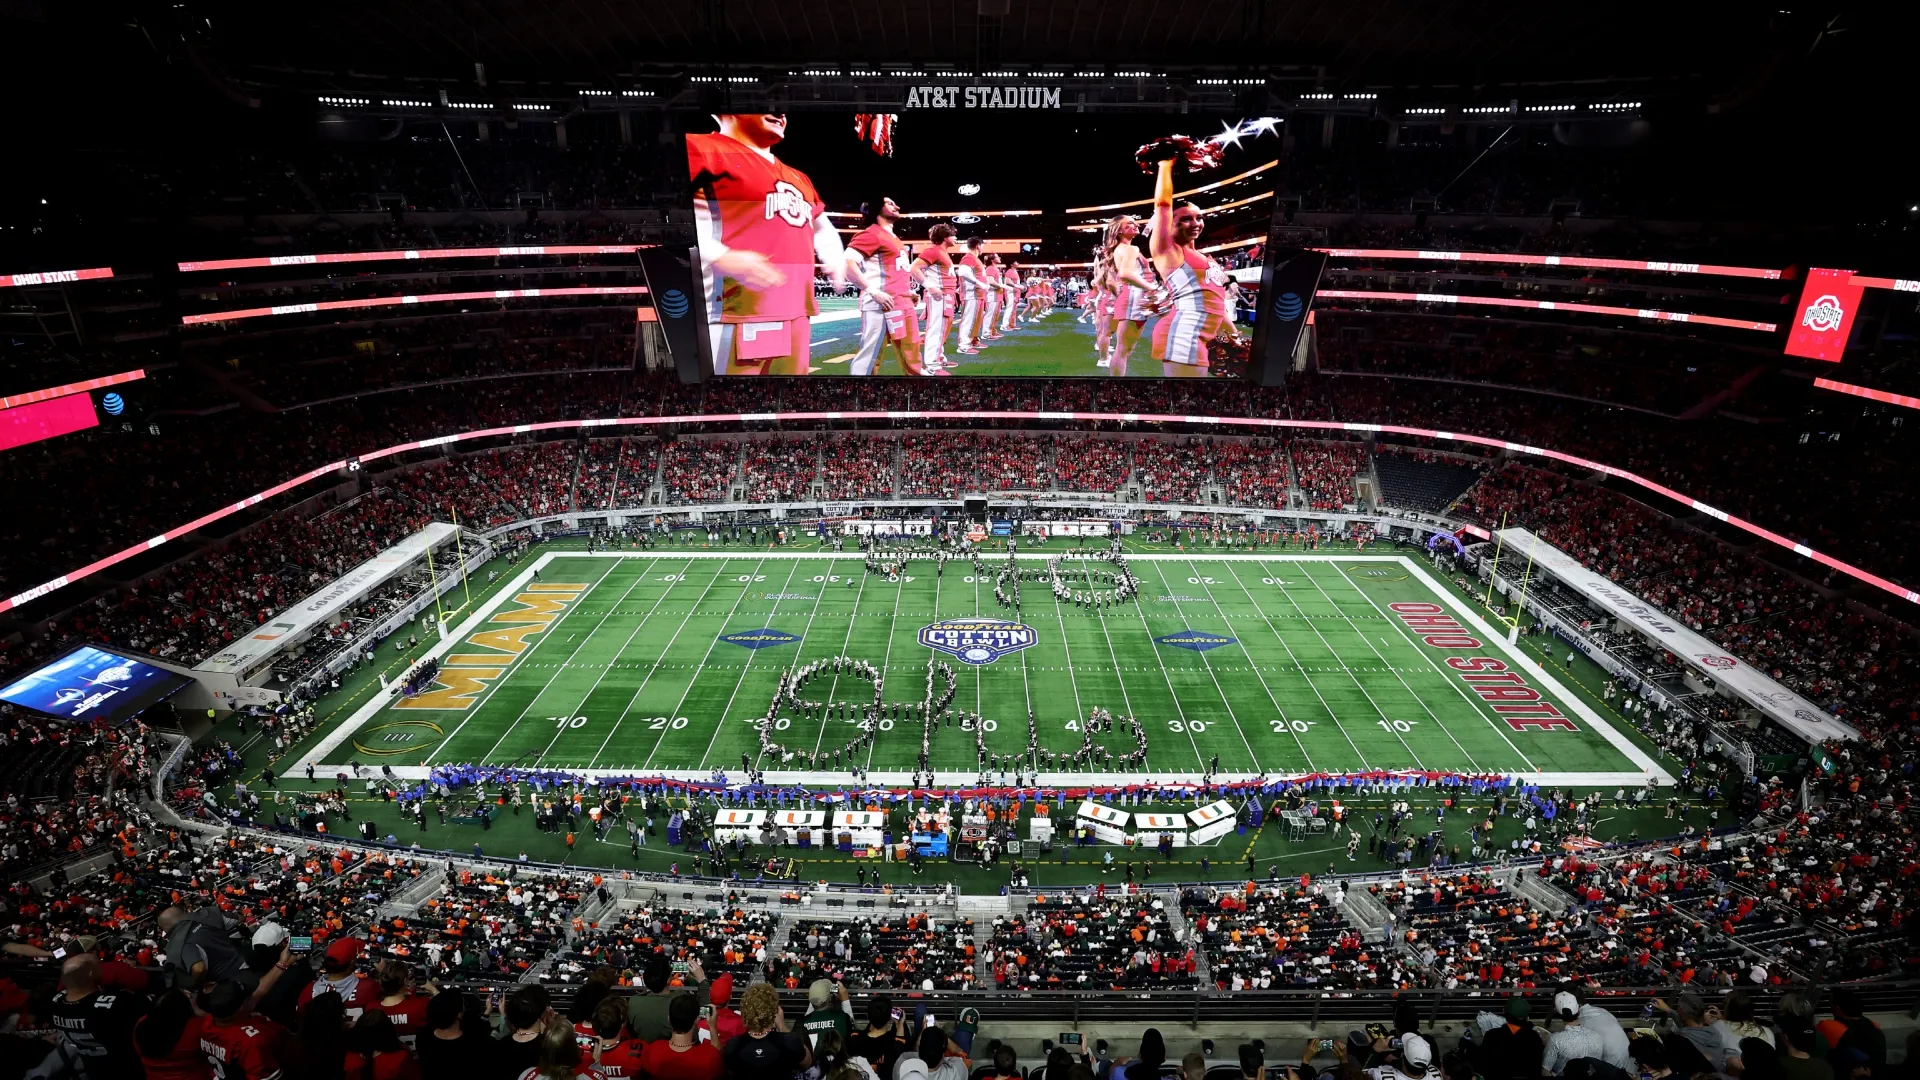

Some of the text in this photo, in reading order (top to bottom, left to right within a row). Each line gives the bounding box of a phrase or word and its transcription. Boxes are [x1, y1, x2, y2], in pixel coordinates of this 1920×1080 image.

[906, 86, 1062, 108] AT&T STADIUM
[520, 246, 544, 255] STATE
[269, 254, 317, 266] BUCKEYES
[1646, 262, 1699, 273] OHIO STATE
[12, 269, 79, 287] OHIO STATE
[1893, 279, 1920, 293] BUC
[271, 303, 318, 315] BUCKEYES
[11, 575, 69, 607] BUCKEYES
[307, 568, 378, 612] GOODYEAR
[1587, 581, 1676, 635] GOODYEAR
[931, 623, 1024, 631] GOODYEAR
[727, 634, 794, 642] GOODYEAR
[928, 630, 1028, 645] COTTON
[946, 638, 1010, 648] BOWL
[1556, 626, 1592, 655] GOODYEAR
[389, 582, 591, 711] MIAMI
[1387, 602, 1582, 732] OHIO STATE
[555, 716, 588, 730] 10
[647, 716, 689, 730] 20
[1167, 719, 1206, 733] 30
[1269, 720, 1309, 733] 20
[1377, 720, 1413, 733] 10
[53, 1014, 86, 1029] ELLIOTT
[200, 1037, 227, 1062] PRYOR
